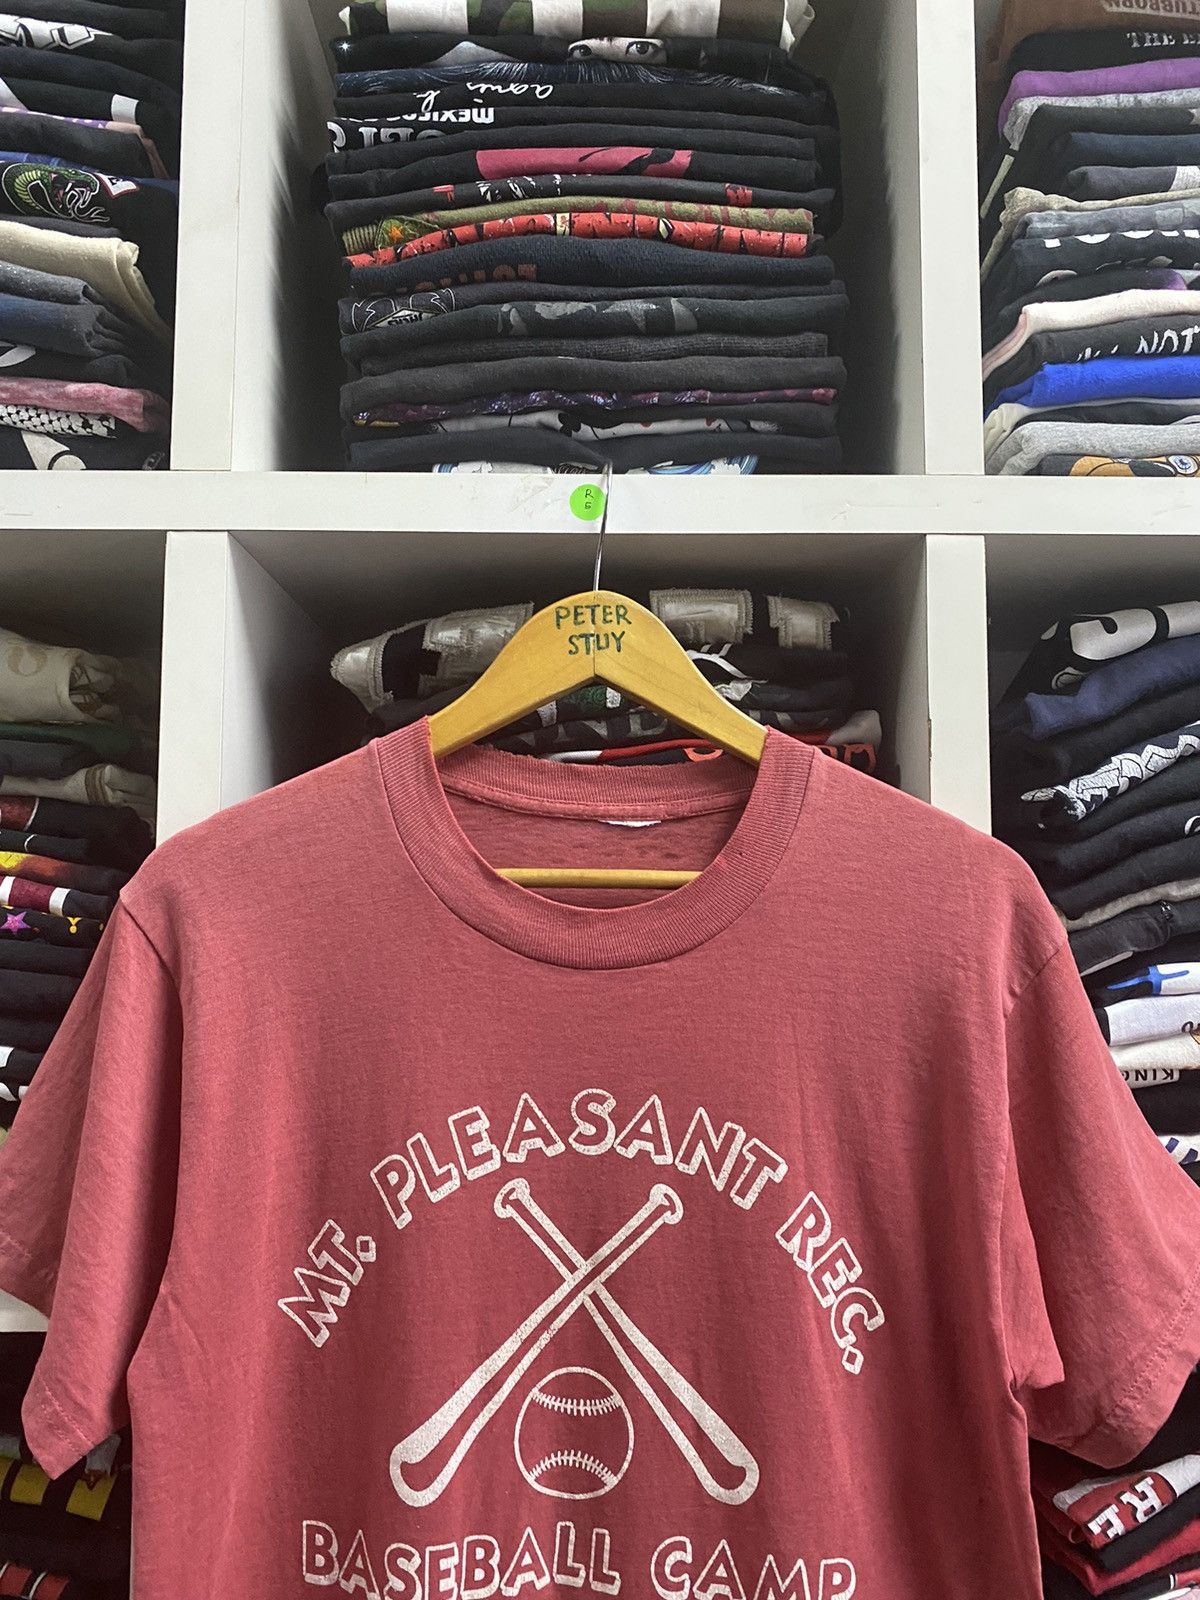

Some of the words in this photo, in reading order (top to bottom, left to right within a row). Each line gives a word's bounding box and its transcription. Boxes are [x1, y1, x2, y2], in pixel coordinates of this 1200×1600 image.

[1126, 32, 1176, 48] THE
[584, 488, 595, 499] R
[554, 604, 632, 630] PETER
[568, 630, 626, 656] STUY
[277, 1218, 377, 1348] MT.
[369, 1088, 789, 1230] PLEASANT
[774, 1190, 886, 1375] REC.
[301, 1519, 622, 1600] BASEBALL
[650, 1535, 858, 1600] CAMP
